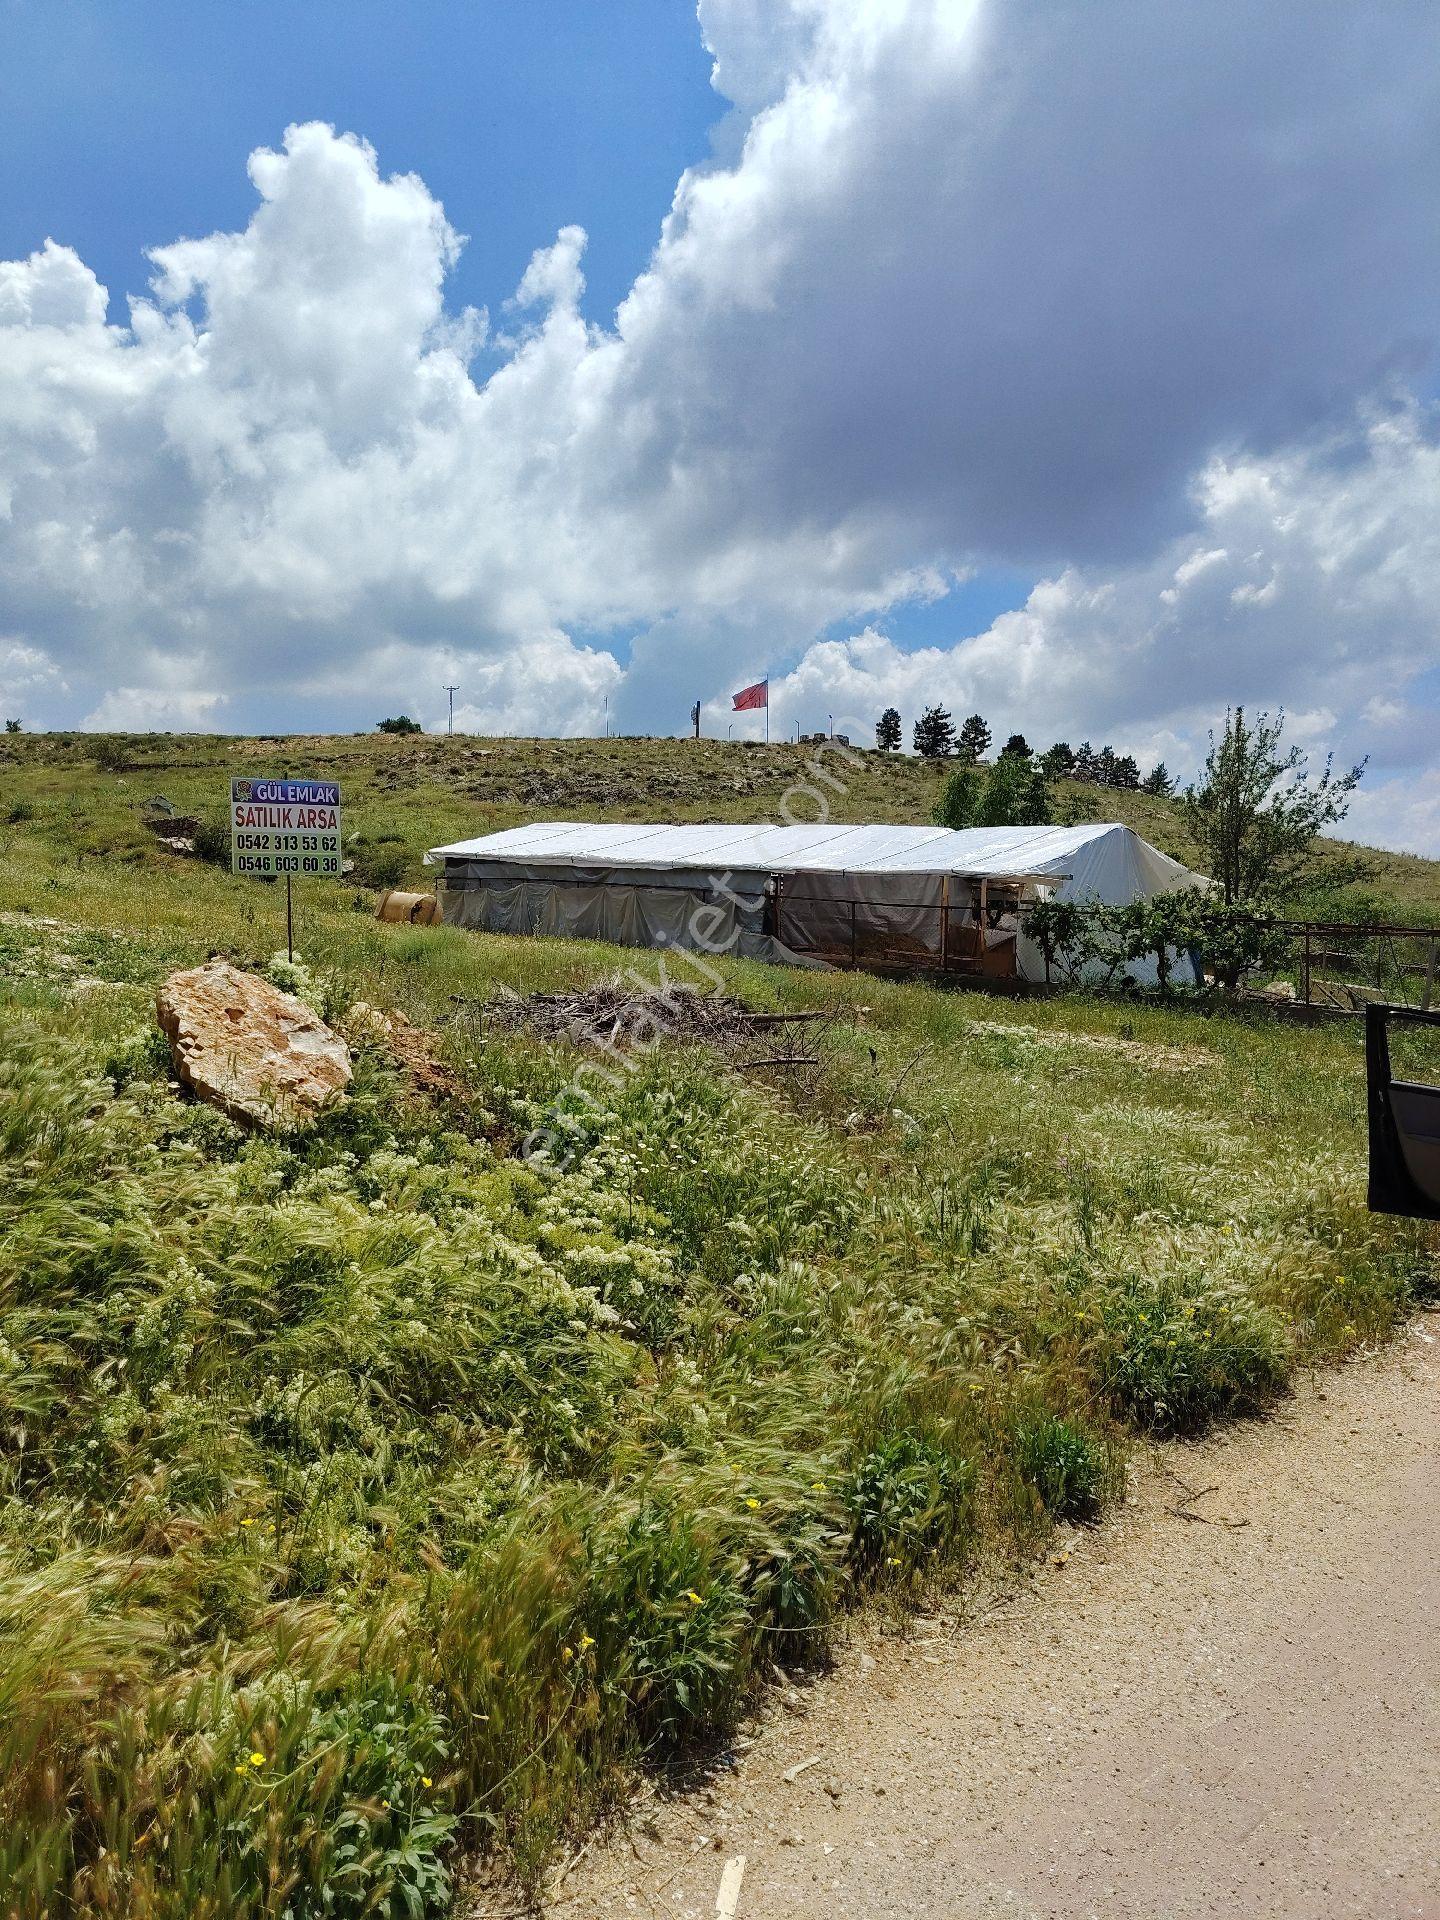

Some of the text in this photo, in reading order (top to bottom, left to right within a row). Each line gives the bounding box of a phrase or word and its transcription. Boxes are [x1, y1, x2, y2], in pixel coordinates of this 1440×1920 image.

[257, 781, 335, 803] GÜL EMLAK
[235, 806, 337, 830] SATILIK ARSA
[237, 834, 337, 852] 0542 313 53 62
[239, 856, 271, 871] 0546
[275, 856, 299, 872] 603
[303, 857, 319, 872] 60
